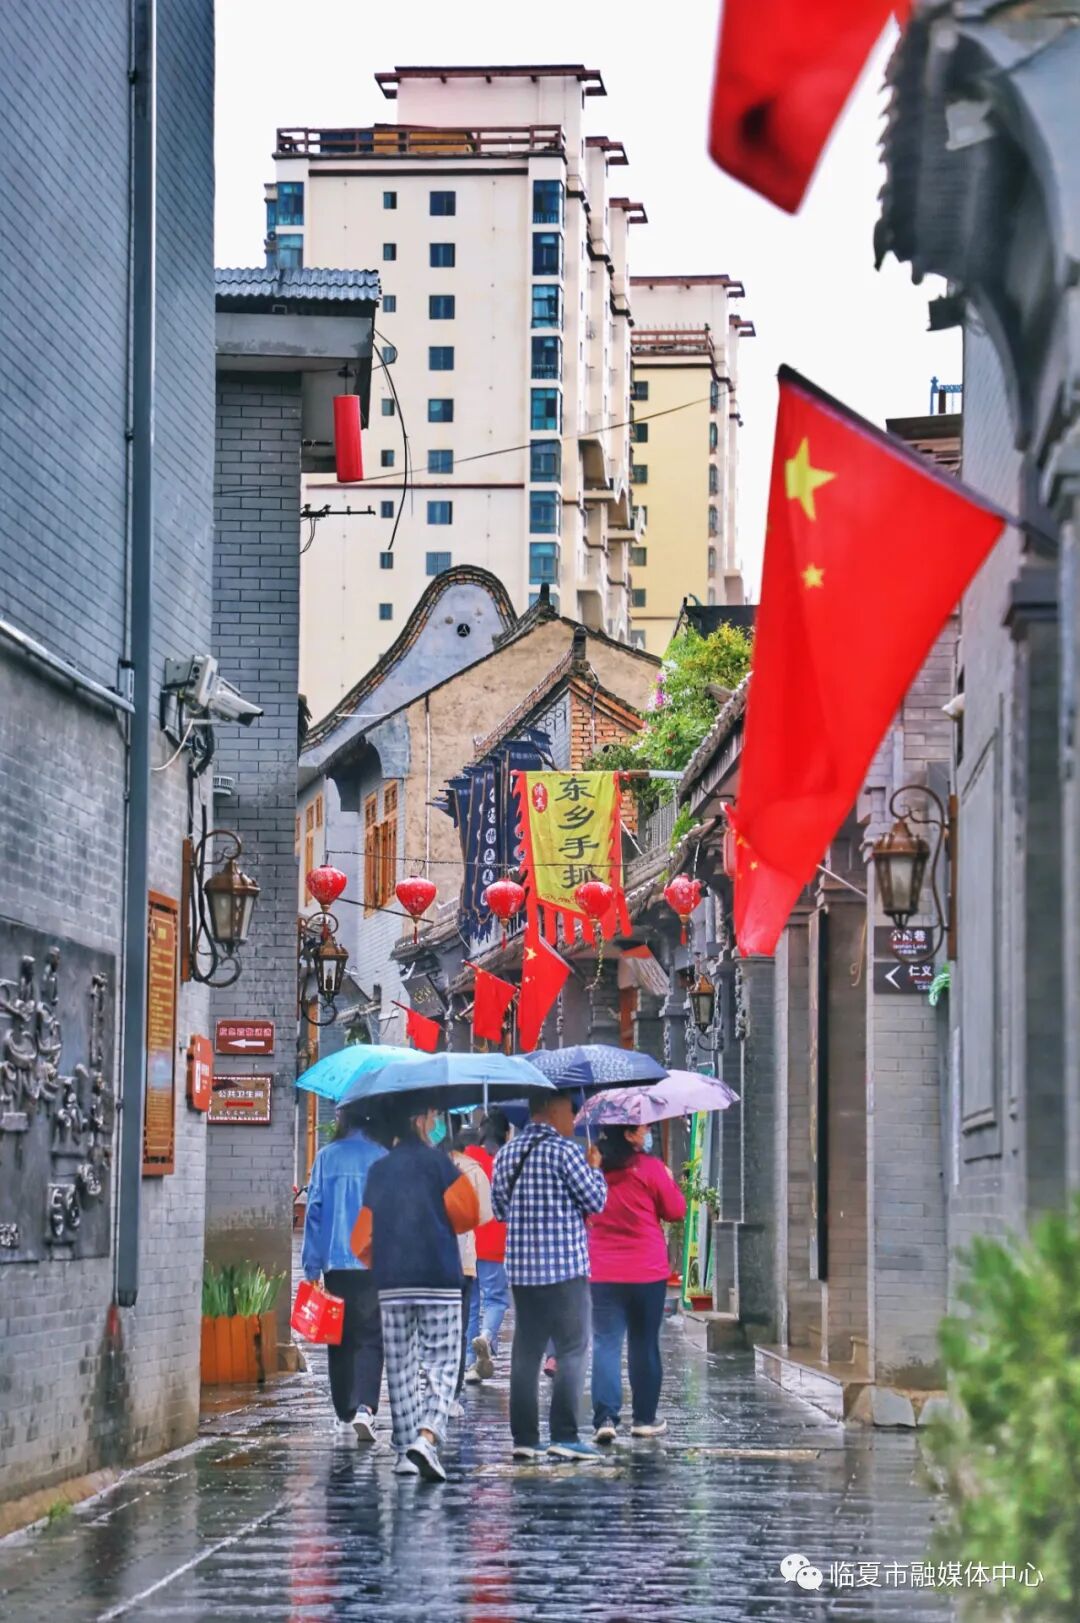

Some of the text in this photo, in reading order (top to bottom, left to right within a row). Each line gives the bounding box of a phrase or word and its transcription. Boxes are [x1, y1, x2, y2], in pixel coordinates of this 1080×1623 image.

[554, 777, 603, 889] 东乡手抓
[908, 965, 932, 976] 仁义
[218, 1090, 264, 1099] 公共卫生间
